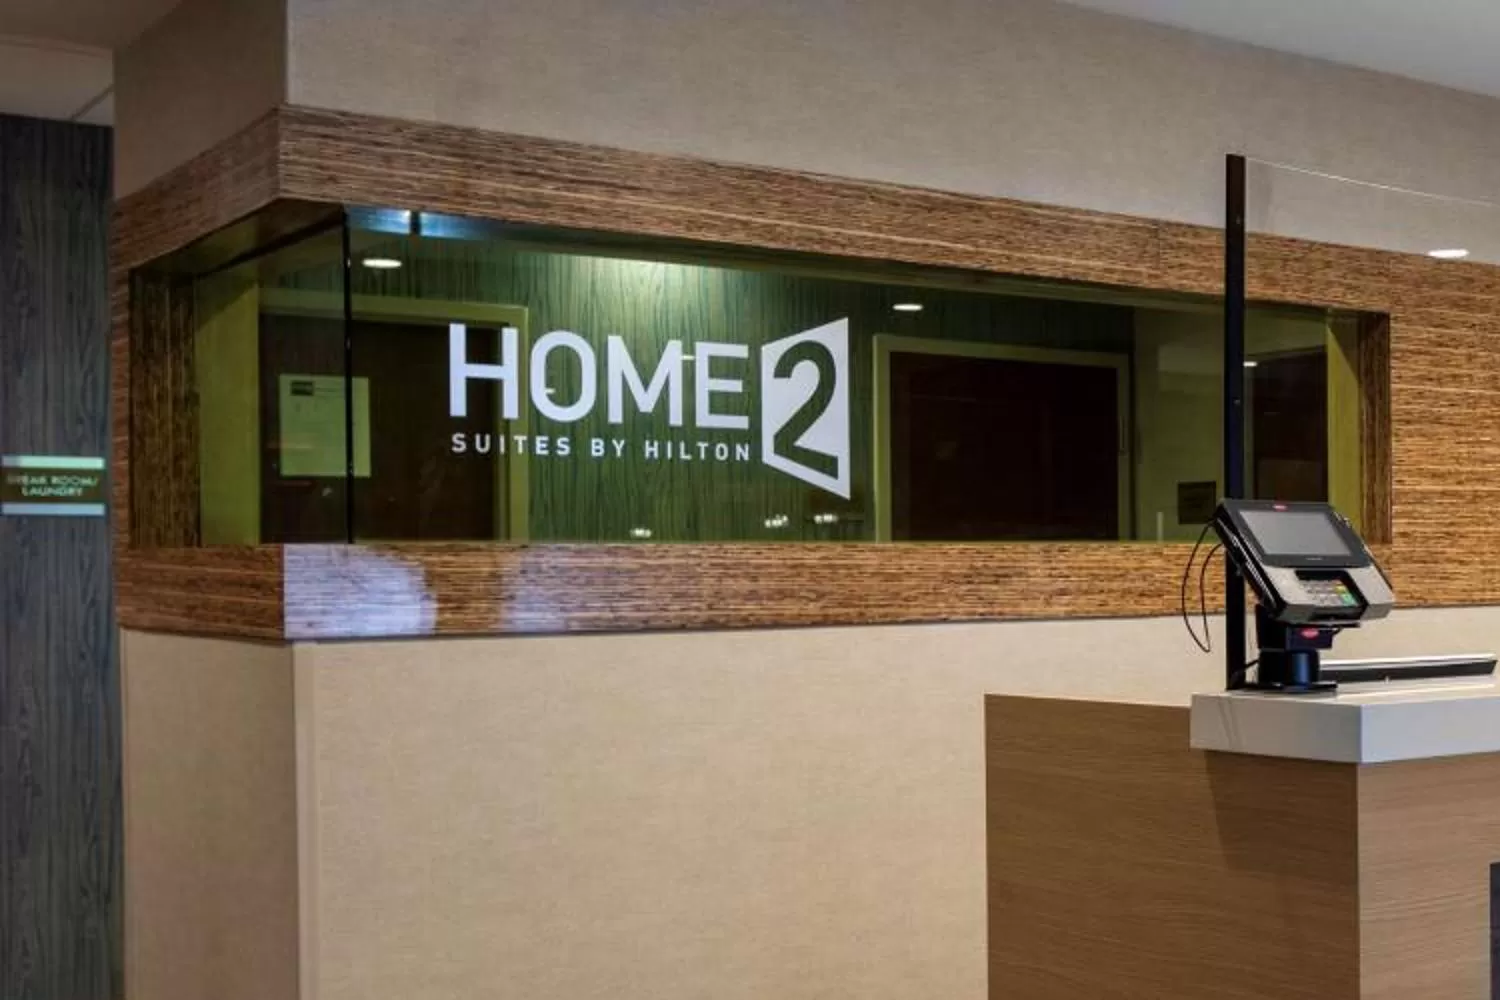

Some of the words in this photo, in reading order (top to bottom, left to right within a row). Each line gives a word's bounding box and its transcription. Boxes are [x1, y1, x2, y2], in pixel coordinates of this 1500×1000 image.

[449, 322, 749, 430] HOME
[770, 336, 842, 483] 2
[450, 432, 572, 457] SUITES
[590, 438, 627, 458] BY
[644, 442, 751, 462] HILTON
